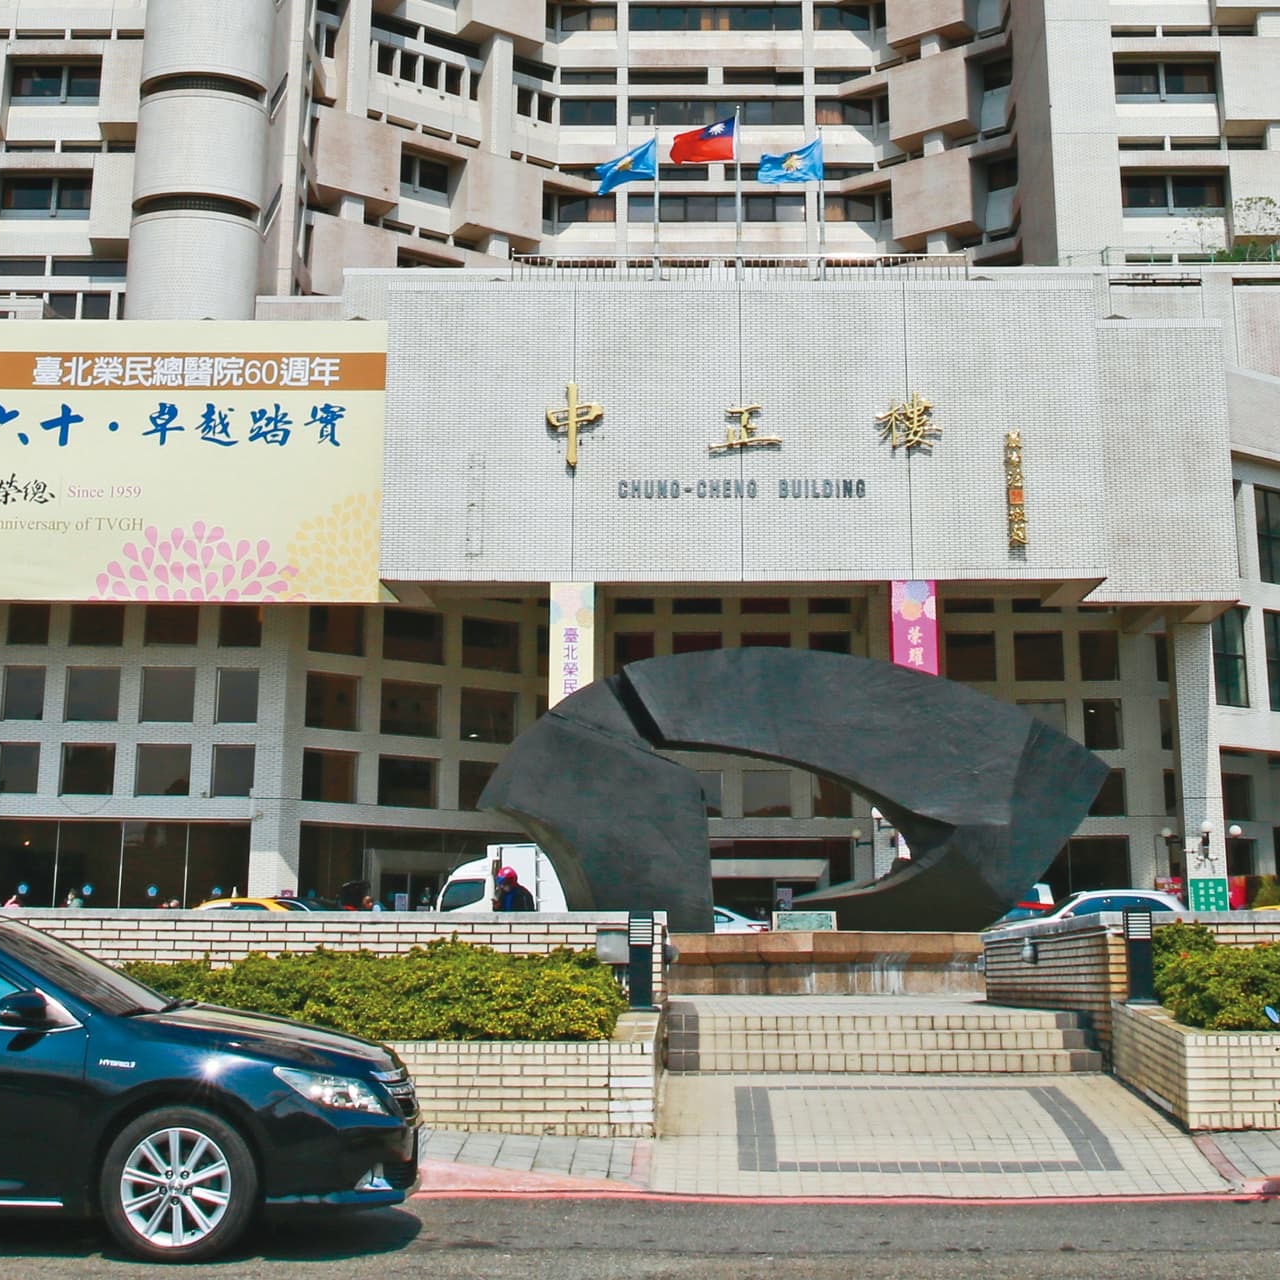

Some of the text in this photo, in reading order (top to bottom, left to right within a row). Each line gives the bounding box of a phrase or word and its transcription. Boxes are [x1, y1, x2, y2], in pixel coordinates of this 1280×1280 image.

[31, 356, 341, 387] 臺北榮民總醫院60週年
[545, 381, 944, 467] 中正樓
[67, 485, 104, 498] Since
[110, 485, 142, 498] 1959
[618, 478, 866, 499] CHUNG-CHENG BUILDING
[75, 517, 92, 531] of
[95, 517, 143, 532] TVGH
